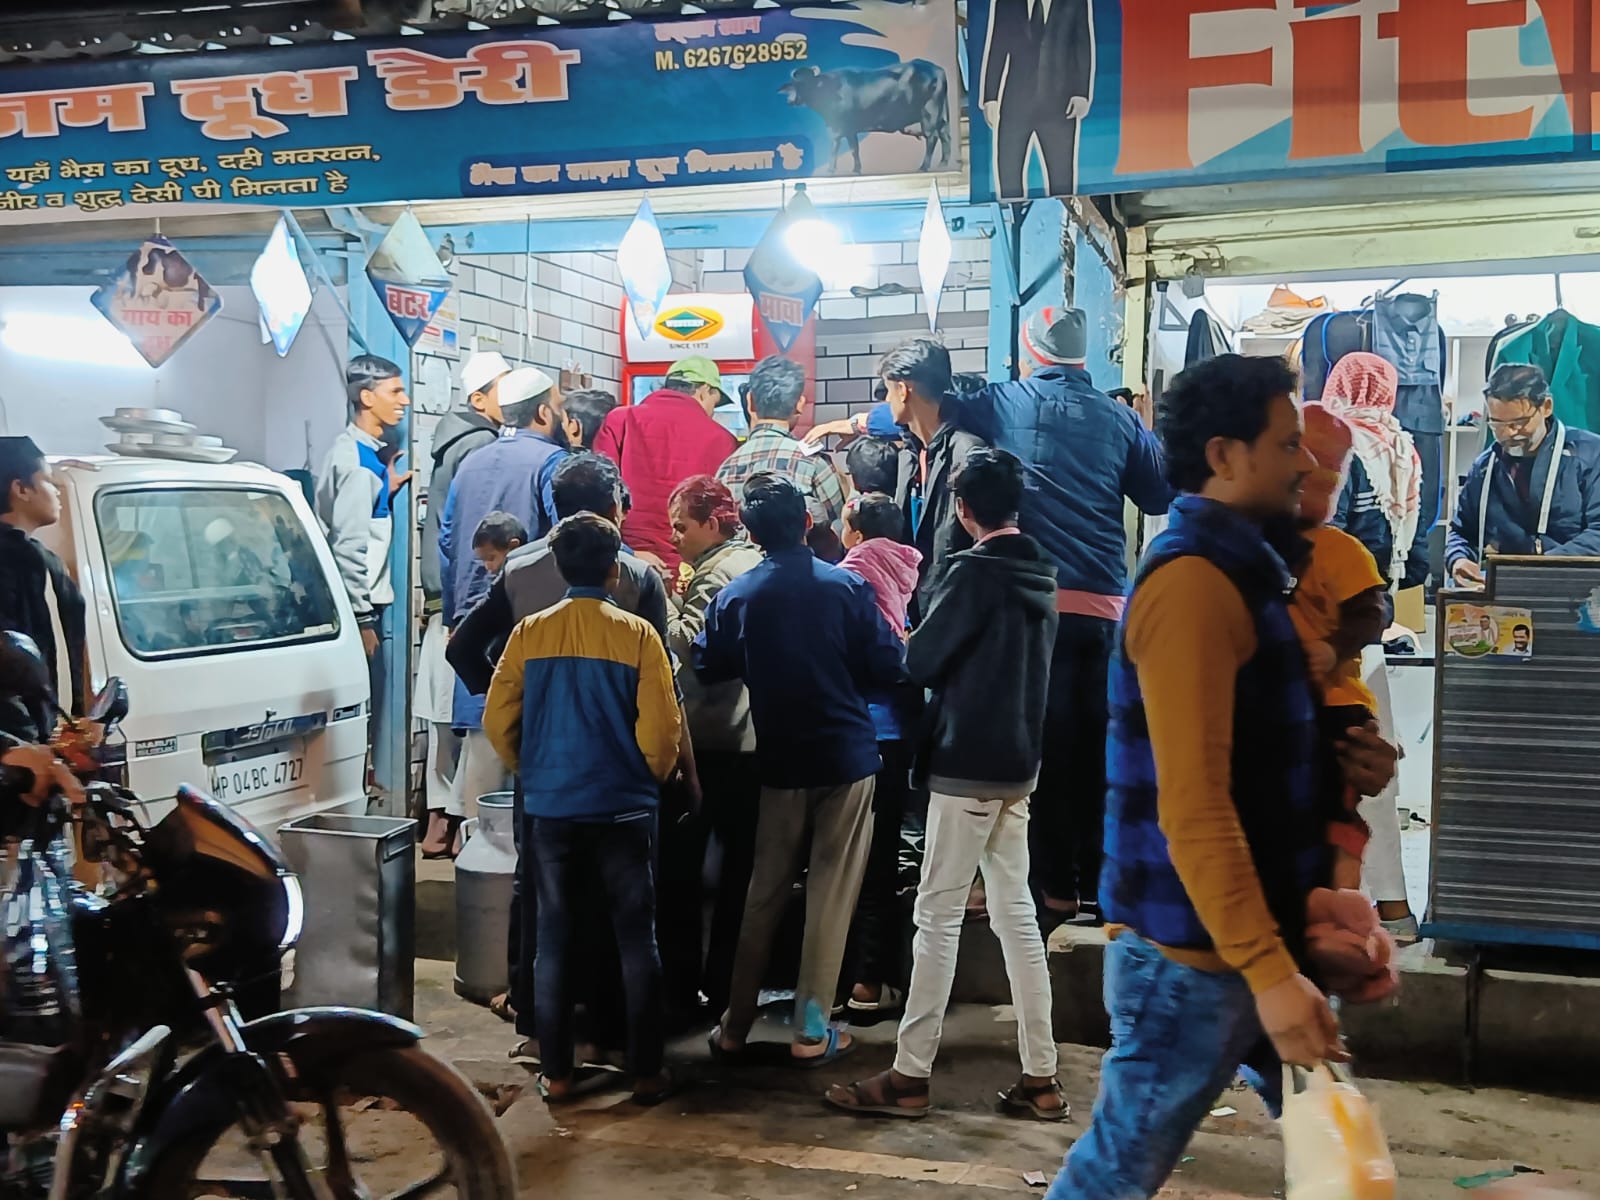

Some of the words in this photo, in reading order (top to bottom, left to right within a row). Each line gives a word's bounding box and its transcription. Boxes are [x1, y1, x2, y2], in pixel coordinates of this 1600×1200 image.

[655, 51, 680, 71] M.
[684, 41, 807, 68] 6267628952
[170, 66, 358, 140] दूध
[366, 40, 581, 110] डेरी
[112, 160, 149, 174] का
[217, 147, 263, 170] दही
[45, 193, 65, 206] व
[74, 190, 125, 211] शुद्ध
[130, 180, 183, 202] देसी
[191, 178, 221, 198] घी
[230, 176, 319, 197] मिलता
[324, 170, 348, 193] है
[121, 309, 163, 326] गाय
[167, 310, 193, 327] का
[385, 284, 432, 322] बटर
[274, 758, 303, 785] 4727
